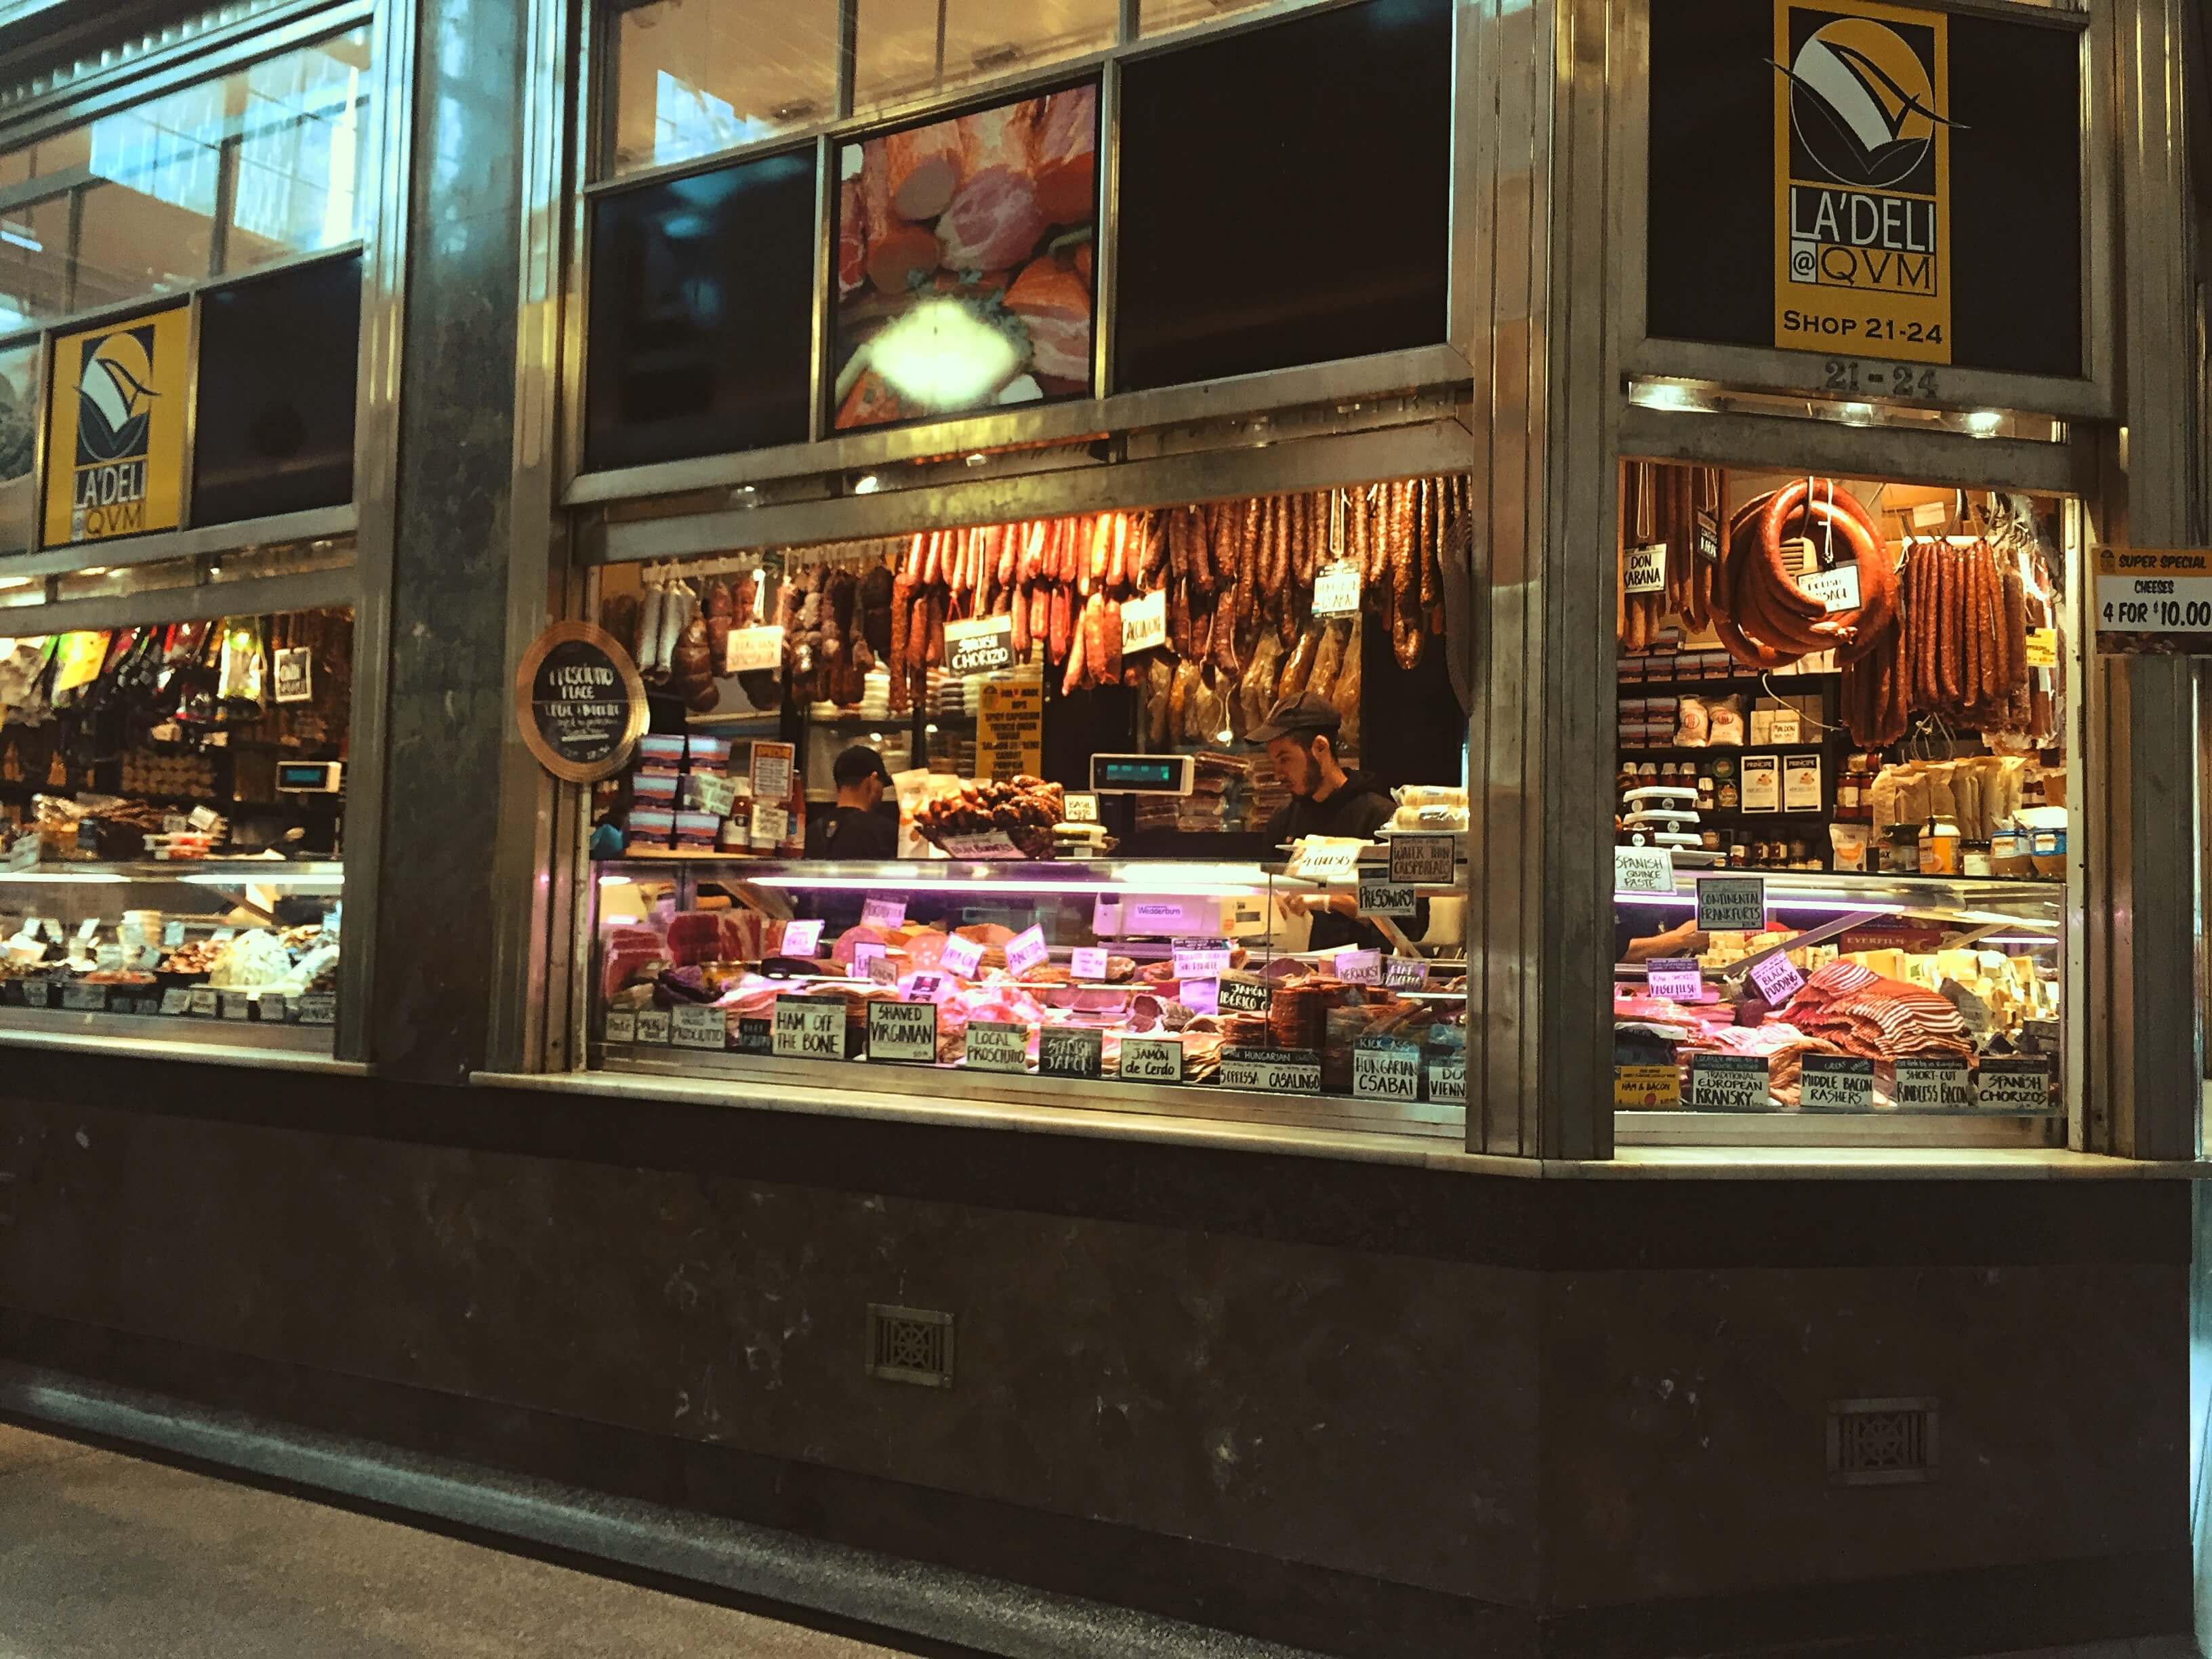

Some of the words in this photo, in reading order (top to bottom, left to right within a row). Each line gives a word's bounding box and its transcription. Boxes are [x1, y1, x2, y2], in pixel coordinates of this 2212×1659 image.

[1791, 188, 1934, 253] LA'DELI
[1784, 310, 1857, 335] SHOP
[1866, 318, 1943, 344] 21-24
[1631, 554, 1652, 570] DON
[2118, 553, 2157, 569] SUPER
[2160, 554, 2207, 569] SPECIAL
[2134, 579, 2175, 594] CHEESES
[2103, 601, 2114, 623] 4
[2118, 602, 2148, 623] FOR
[2152, 600, 2211, 626] $10.00
[951, 647, 1008, 670] CHORIZO
[1615, 856, 1663, 869] SPANISH
[1626, 869, 1662, 879] QUINCE
[1624, 878, 1656, 889] PASTE
[1359, 885, 1415, 909] PRESSWURST
[1701, 893, 1761, 905] CONTINENTAL
[1137, 905, 1181, 915] Wedderburn
[1761, 964, 1788, 985] BLACK
[1764, 971, 1798, 999] PUDDING
[777, 1011, 806, 1031] HAM
[813, 1014, 835, 1031] OFF
[878, 1005, 922, 1021] SHAVED
[870, 1021, 933, 1044] VIRGINIAN
[975, 1031, 1011, 1047] LOCAL
[777, 1033, 797, 1049] THE
[802, 1032, 840, 1054] BONE
[1359, 1038, 1383, 1049] KICK
[966, 1045, 1025, 1064] PROSCIUTTO
[1125, 1061, 1141, 1073] de
[1145, 1061, 1175, 1076] Cerdo
[1355, 1057, 1418, 1077] HUNGARIAN
[1441, 1067, 1465, 1080] DO
[1704, 1070, 1757, 1080] TRADITIONAL
[1269, 1071, 1320, 1090] CASALINGO
[1358, 1073, 1413, 1095] CSABAI
[1430, 1080, 1466, 1097] VIENN
[1621, 1082, 1637, 1091] HAM
[1646, 1082, 1670, 1091] BACON
[1698, 1078, 1762, 1091] EUROPEAN
[1802, 1073, 1839, 1090] MIDDLE
[1843, 1077, 1872, 1092] BACON
[1988, 1074, 2042, 1091] SPANISH
[1696, 1087, 1753, 1107] KRANSKY
[1810, 1088, 1862, 1105] RASHERS
[1897, 1081, 1938, 1103] RINDLESS
[1979, 1089, 2047, 1105] CHORIZOS
